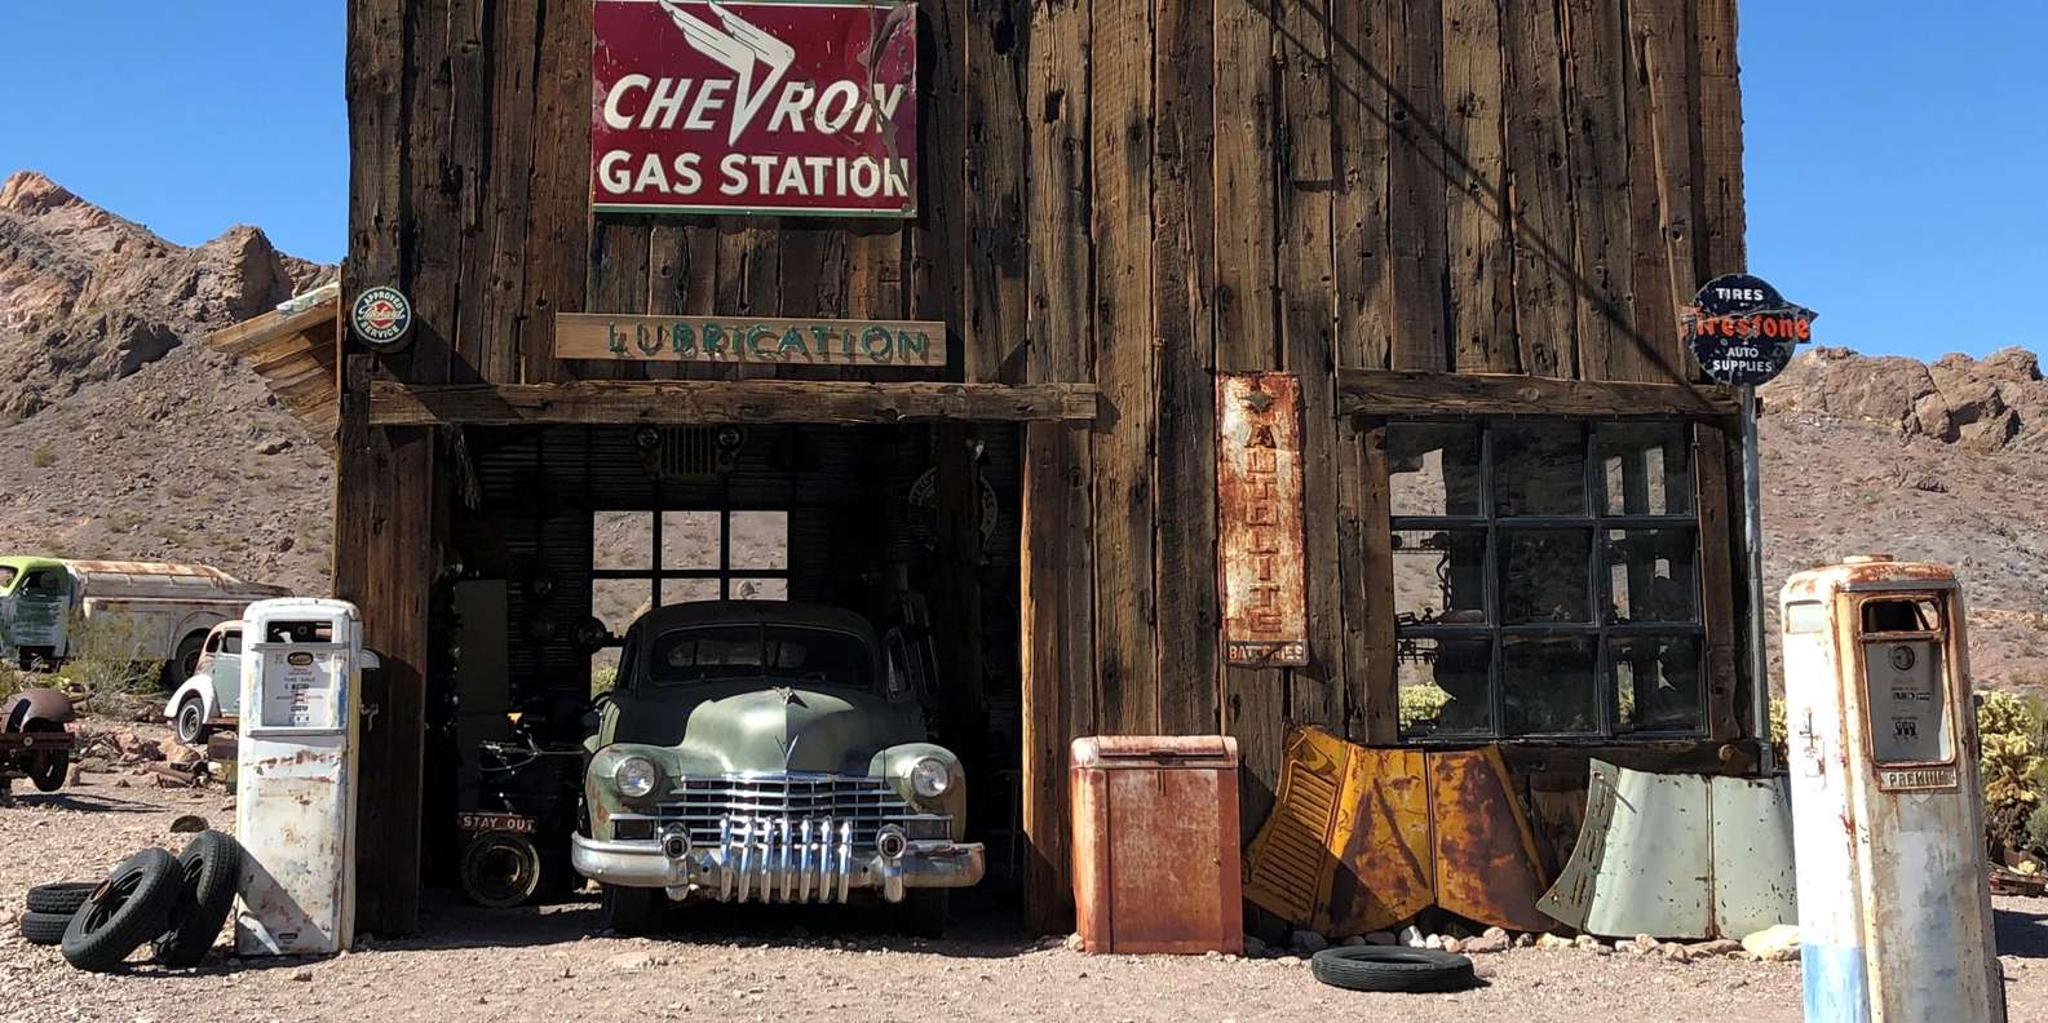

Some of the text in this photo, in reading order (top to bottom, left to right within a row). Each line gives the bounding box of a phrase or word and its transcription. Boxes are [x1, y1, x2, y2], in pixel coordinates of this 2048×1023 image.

[602, 70, 905, 147] CHEVRON
[599, 150, 909, 198] GAS STATION
[1715, 287, 1764, 302] TIRES
[360, 321, 400, 338] SERVICE
[608, 321, 930, 360] LUBRICATION
[1726, 346, 1759, 359] AUTO
[1712, 359, 1773, 373] SUPPLIES
[463, 816, 535, 831] STAY OUT
